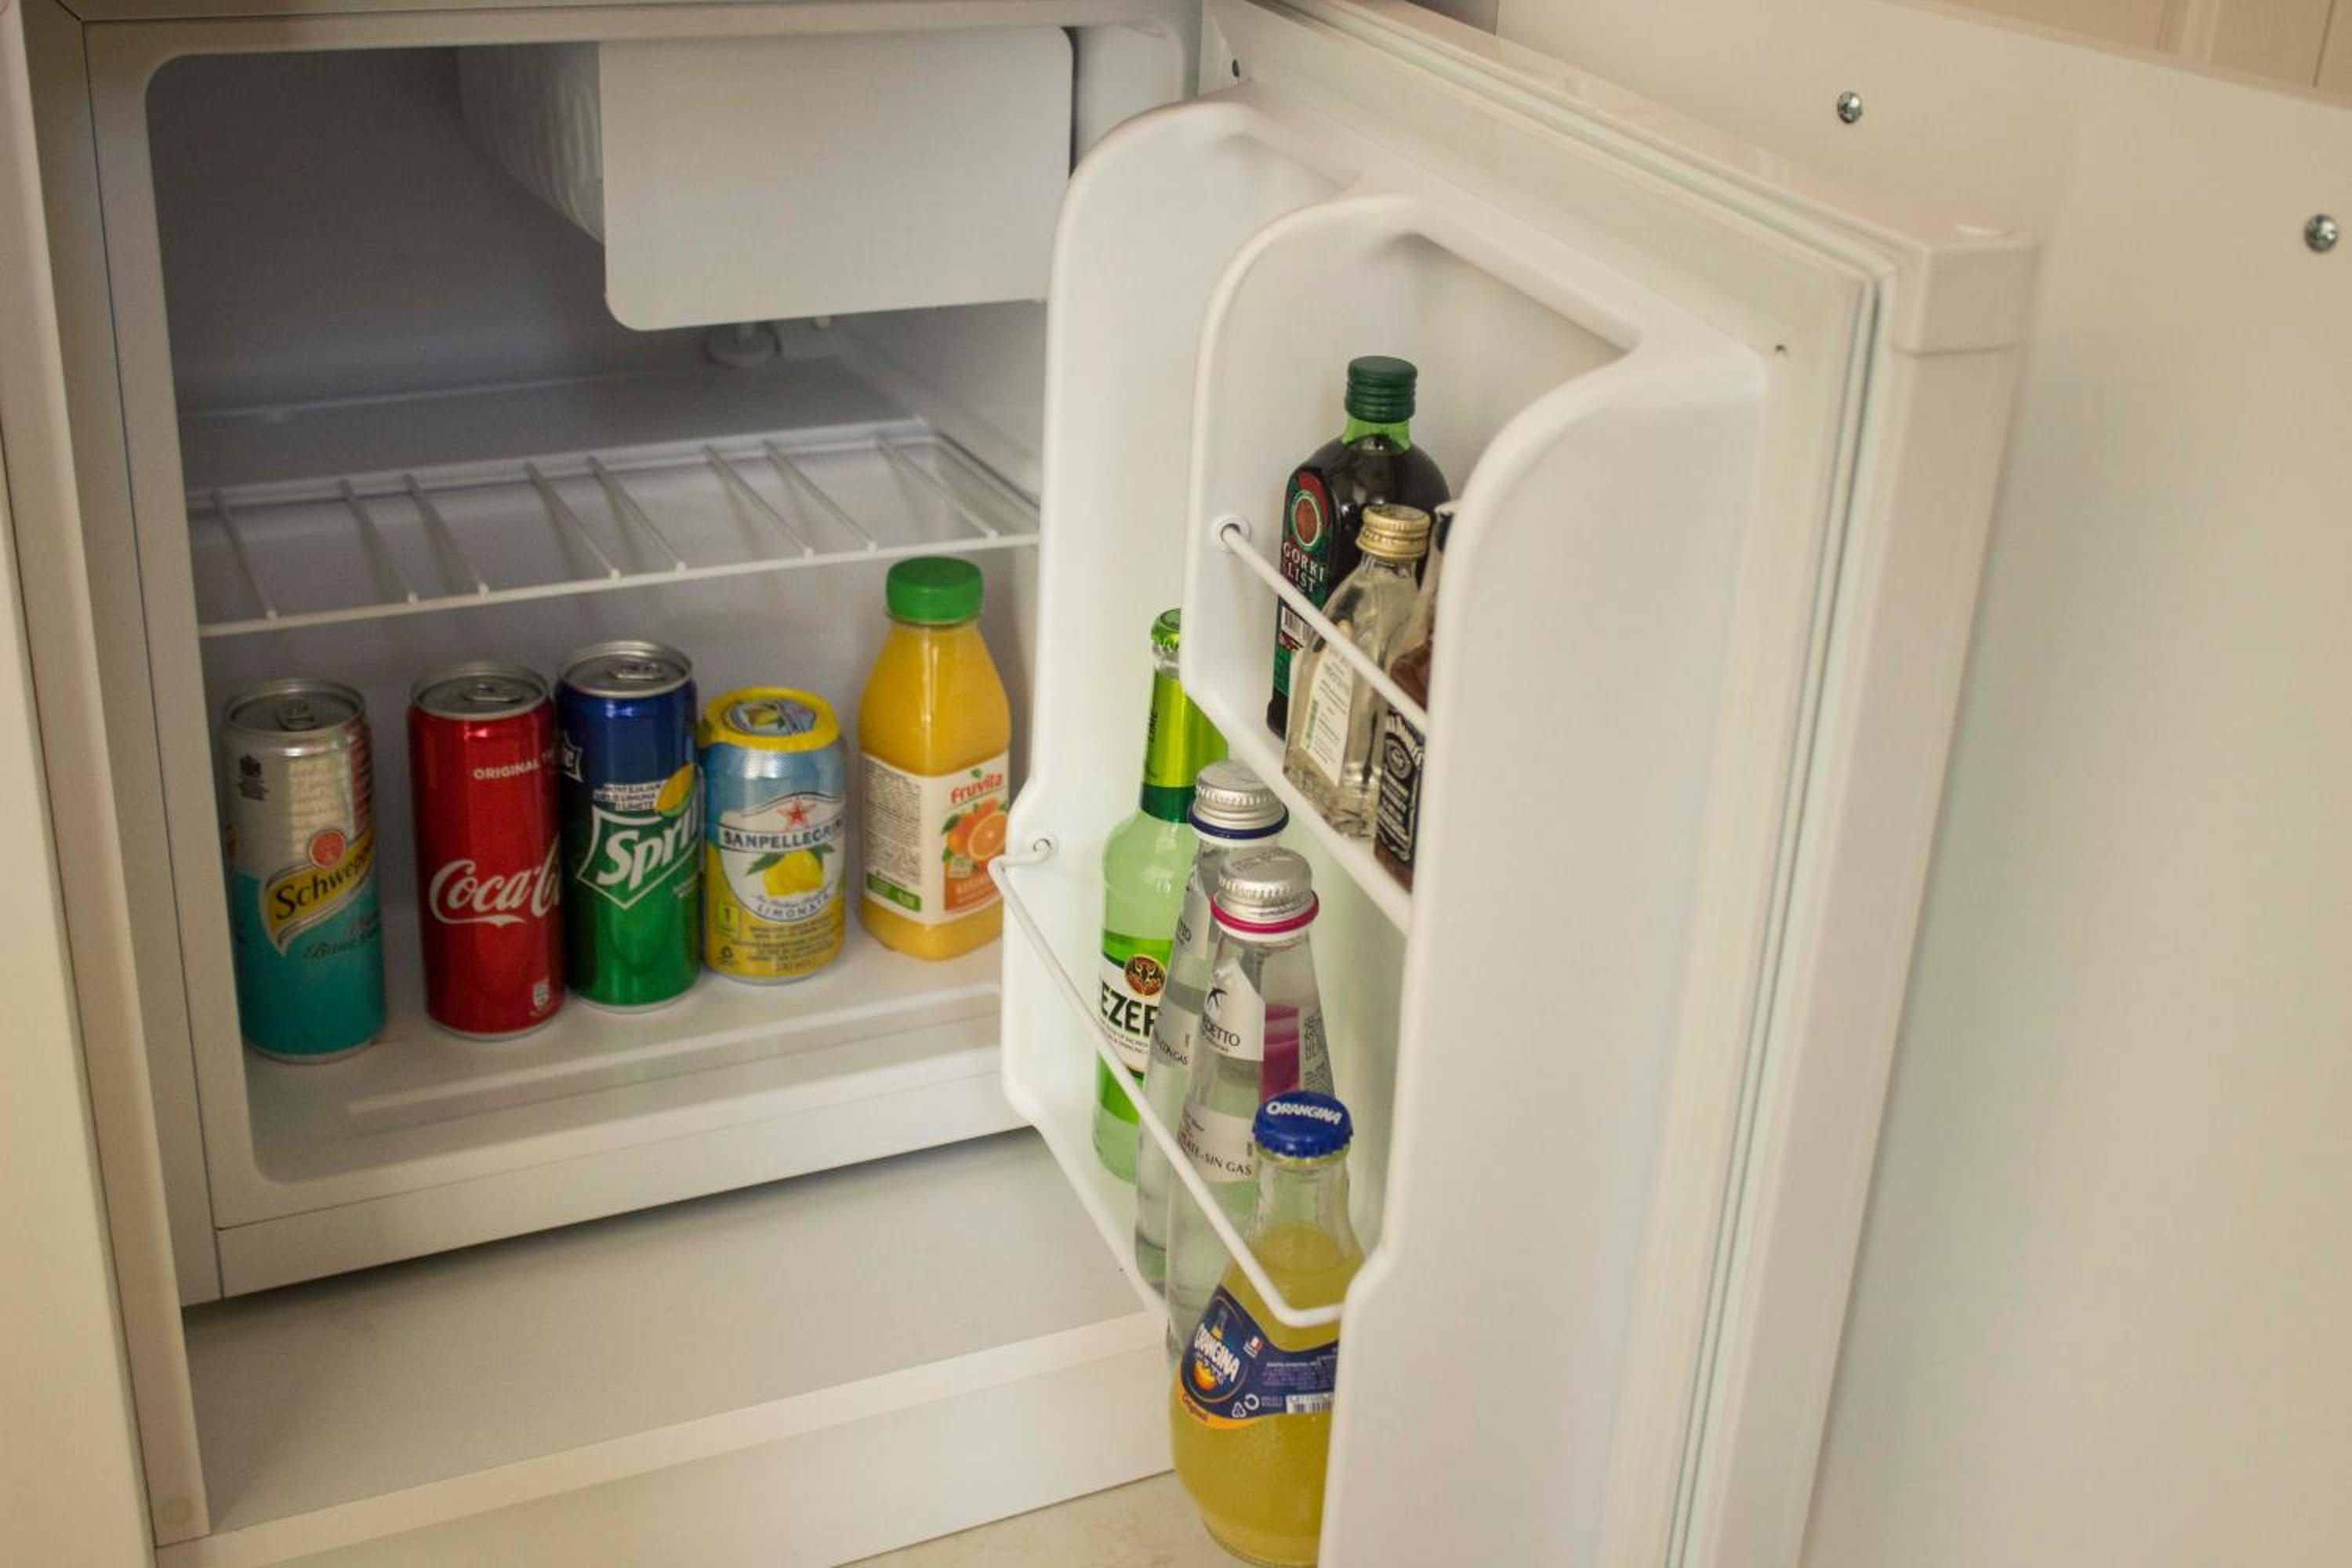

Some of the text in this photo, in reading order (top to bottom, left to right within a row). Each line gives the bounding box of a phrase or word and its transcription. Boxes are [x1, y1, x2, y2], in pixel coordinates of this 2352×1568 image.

[1283, 541, 1325, 583] GORKI
[1287, 561, 1317, 593] LIST
[473, 757, 540, 781] ORIGINAL
[1266, 1101, 1343, 1126] ORANGINA
[1225, 1160, 1252, 1177] GAS
